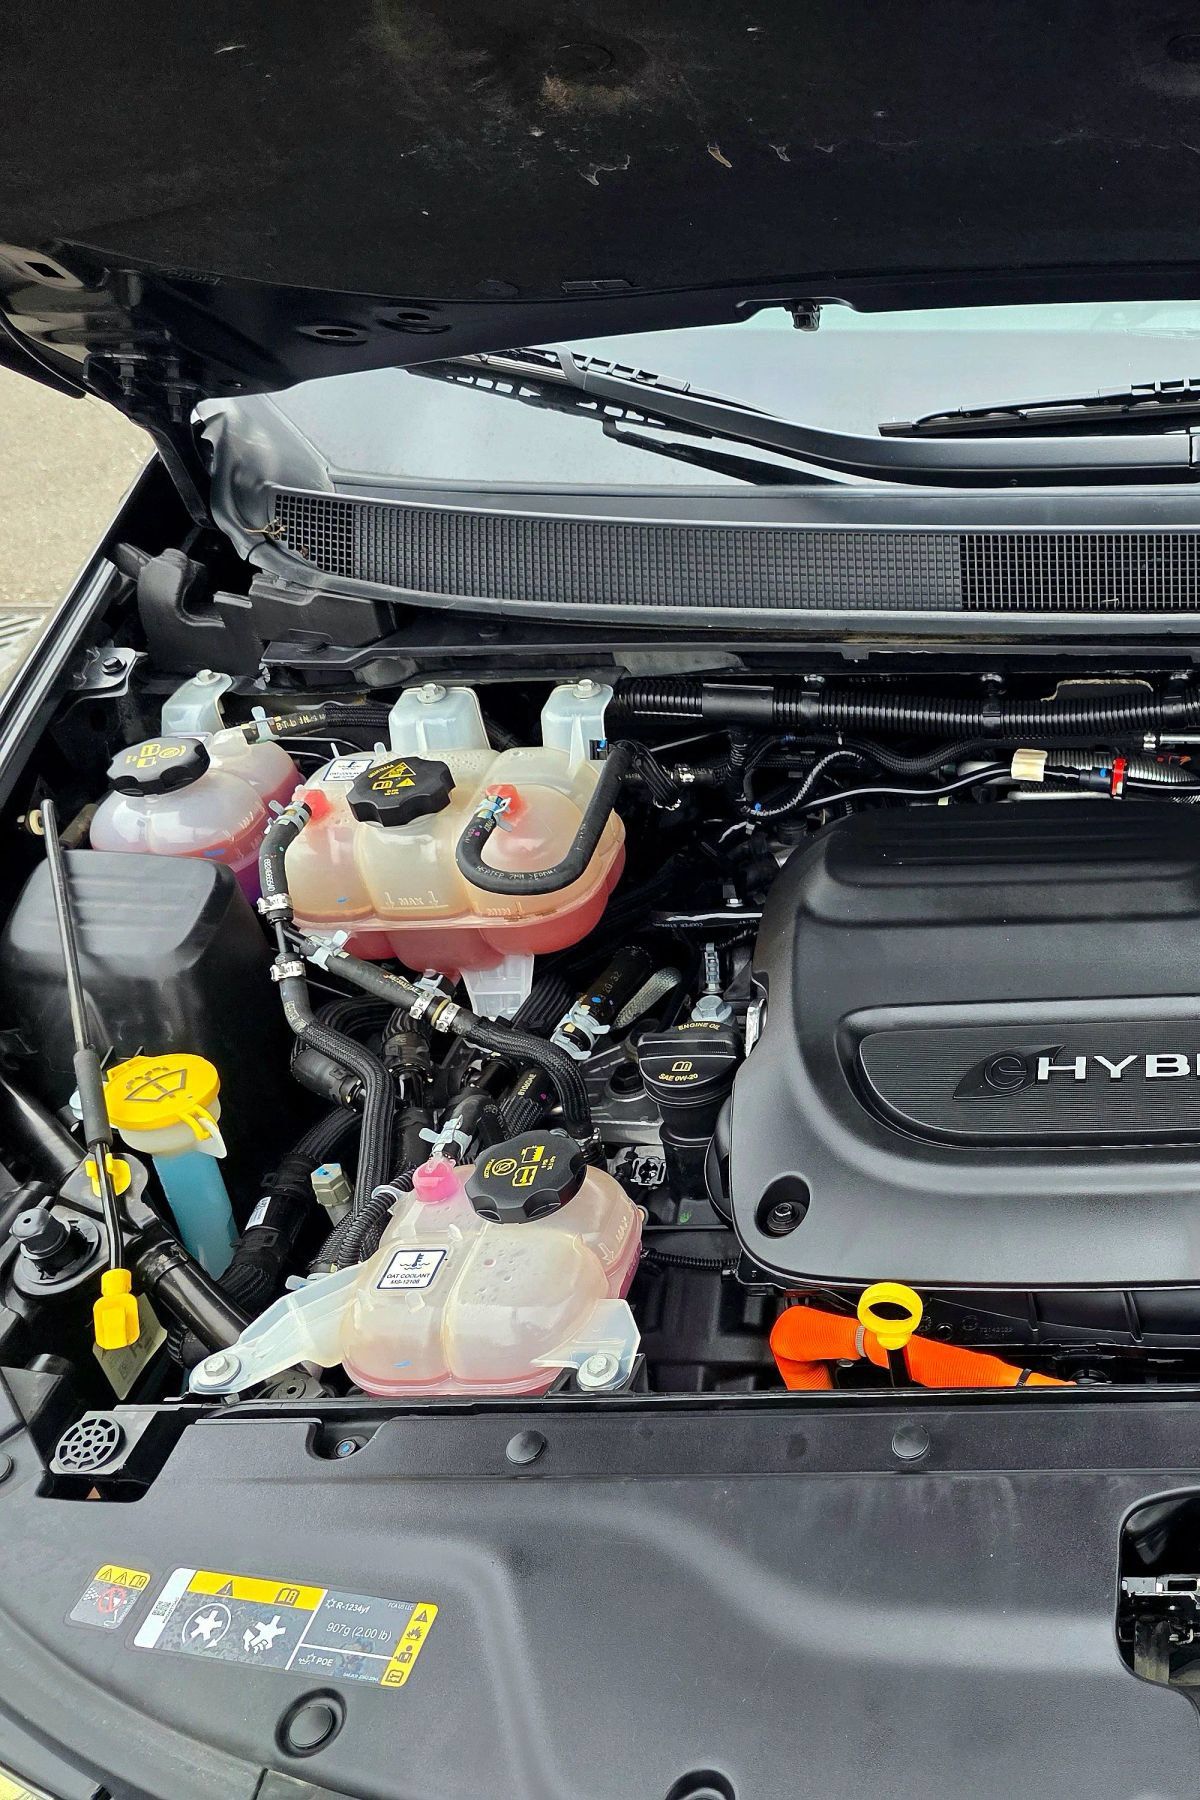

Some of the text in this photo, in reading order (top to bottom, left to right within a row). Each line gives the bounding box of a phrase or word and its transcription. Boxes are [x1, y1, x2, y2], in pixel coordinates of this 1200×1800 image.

[678, 1022, 708, 1031] ENGINE
[659, 1073, 674, 1081] SAE
[326, 1622, 392, 1643] 907g (2.00 lb)
[316, 1657, 334, 1667] POE
